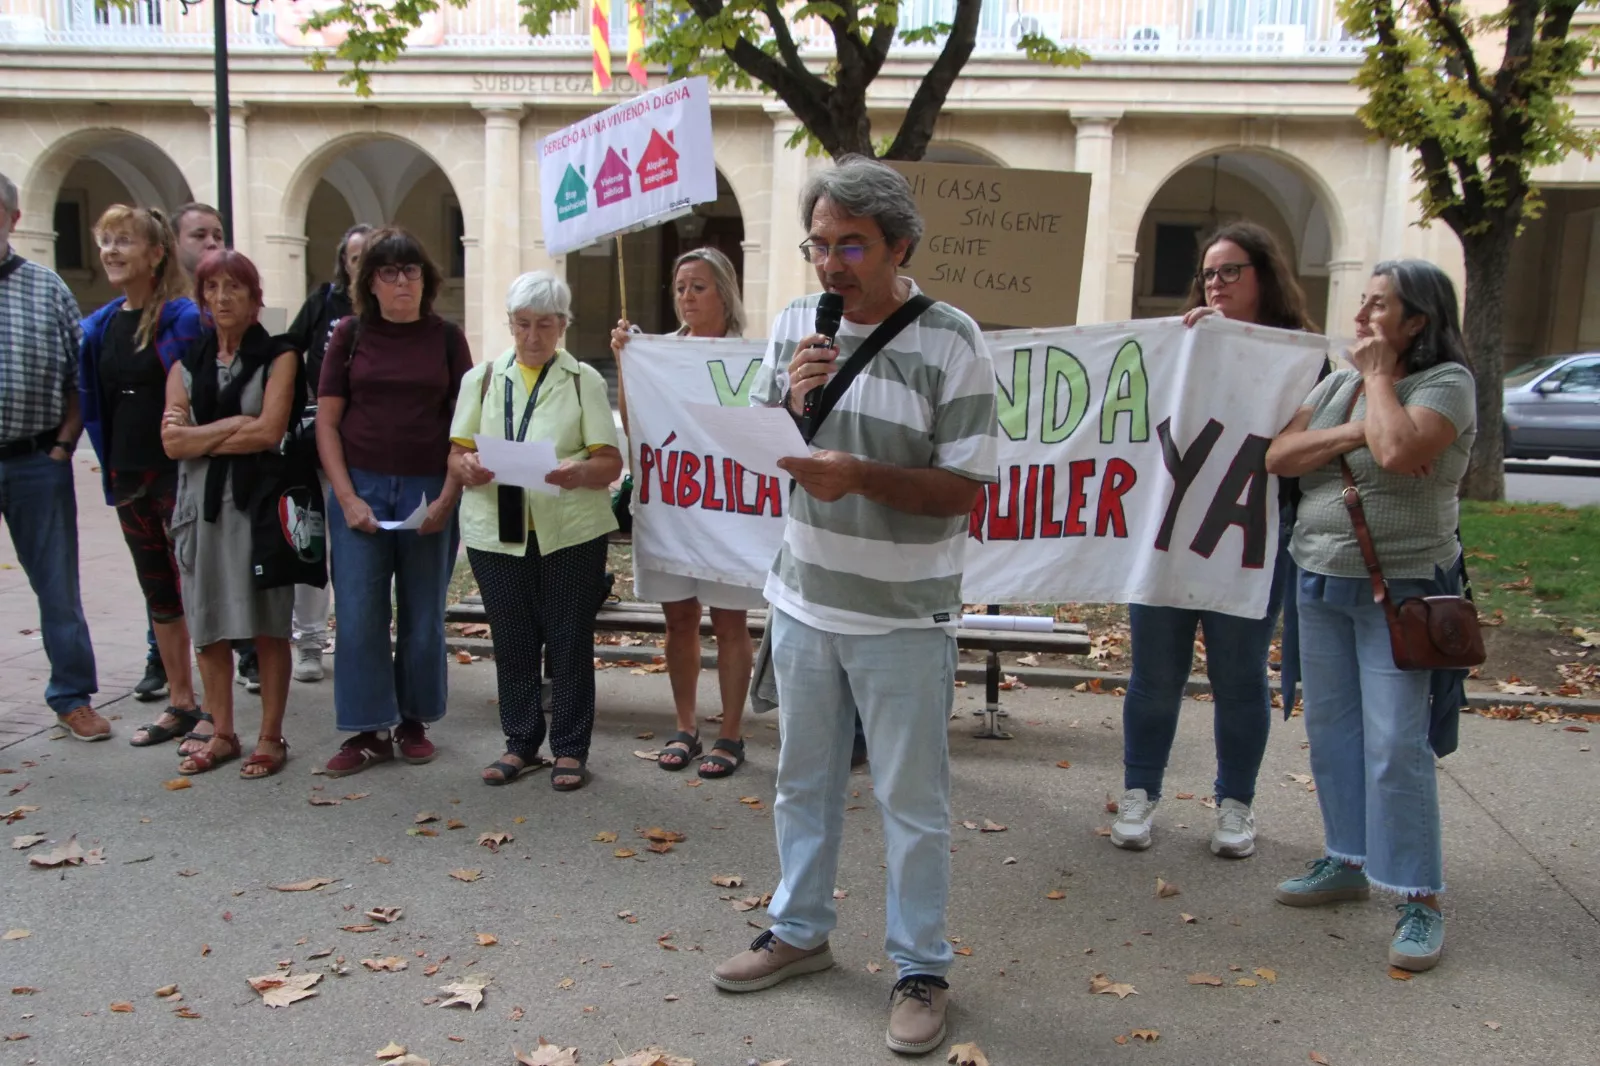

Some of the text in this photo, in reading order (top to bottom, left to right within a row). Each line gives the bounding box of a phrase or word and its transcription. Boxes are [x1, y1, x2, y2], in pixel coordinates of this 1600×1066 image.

[472, 74, 648, 93] SUBDELEGAIO
[543, 86, 690, 156] DERECHO A UNA VIVIENDA DIGNA
[937, 178, 1002, 202] CASAS
[959, 205, 1064, 233] SIN GENTE
[929, 235, 992, 256] GENTE
[928, 263, 1032, 293] SIN CASAS
[1154, 416, 1273, 569] YA
